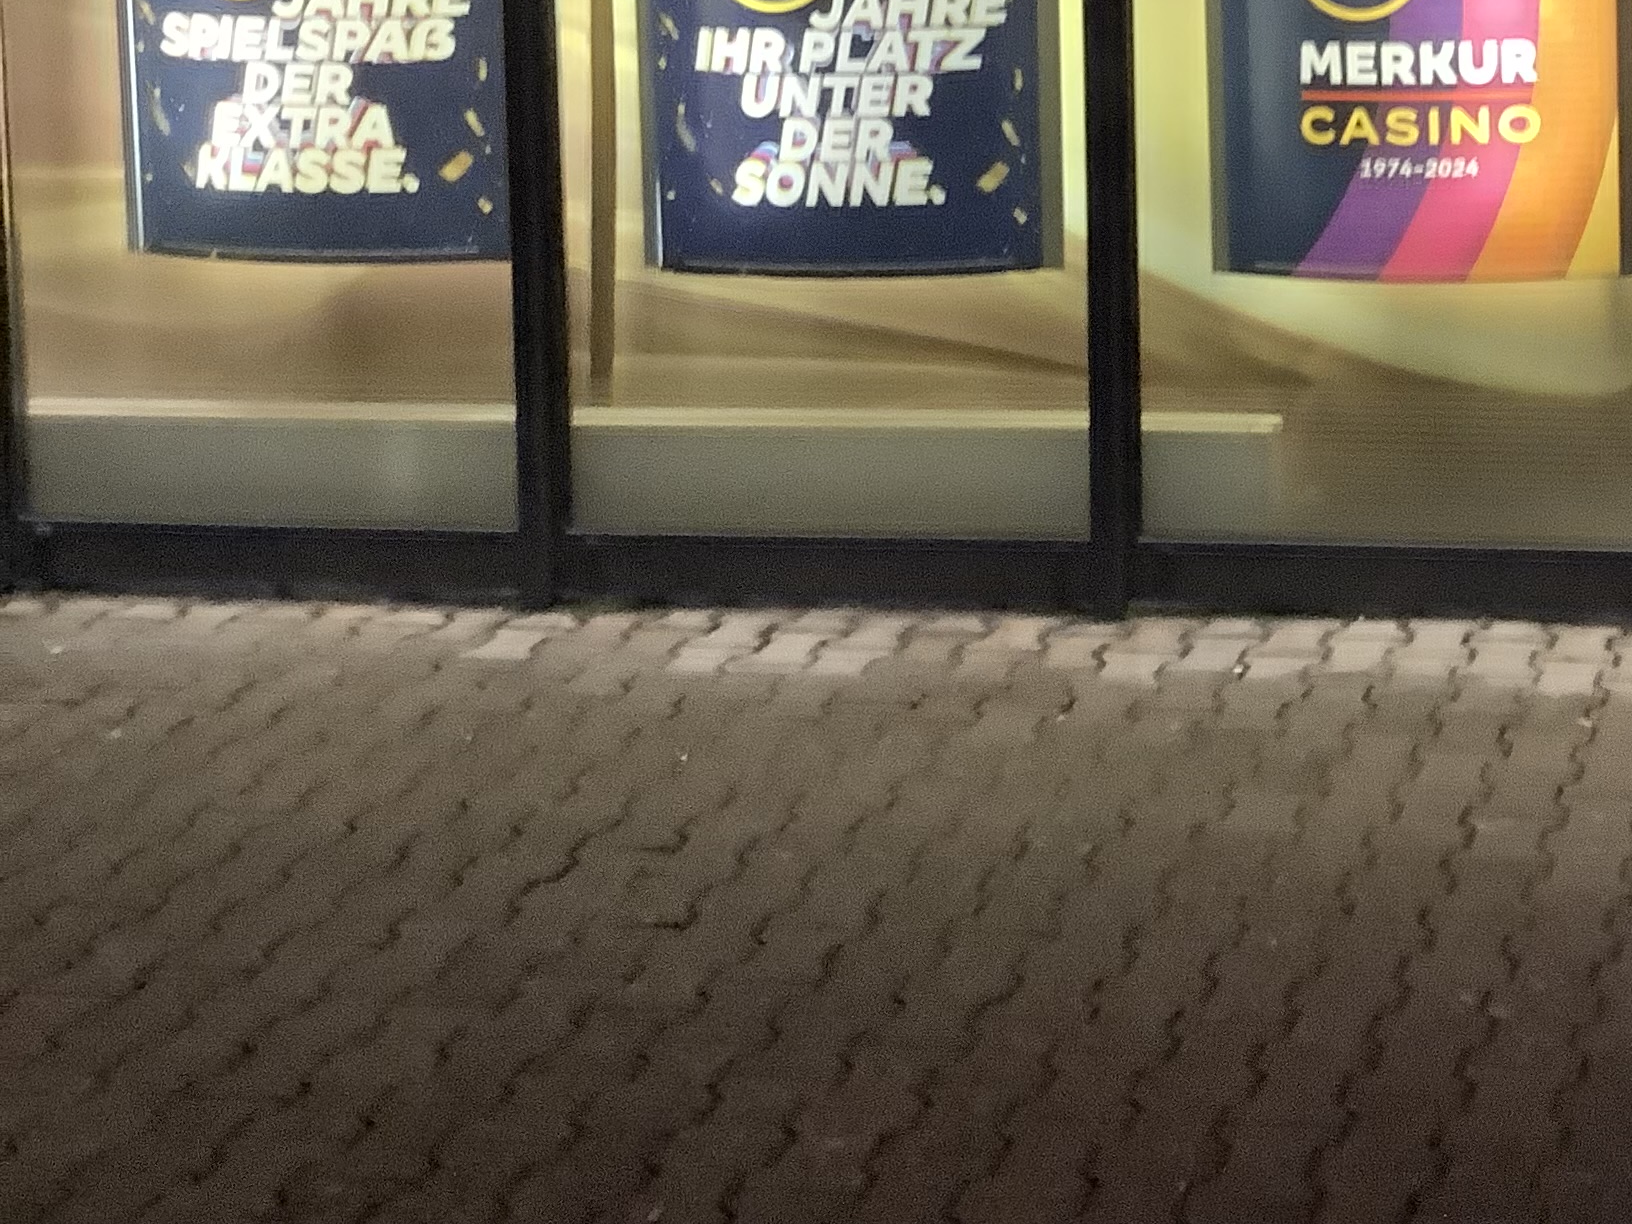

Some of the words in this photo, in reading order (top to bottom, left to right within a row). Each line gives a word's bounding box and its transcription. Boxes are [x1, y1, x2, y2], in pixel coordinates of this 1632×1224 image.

[695, 26, 787, 73] IHR
[800, 28, 986, 73] PLATZ
[1300, 38, 1537, 85] MERKUR
[242, 62, 354, 105] DER
[740, 73, 933, 118] UNTER
[211, 102, 395, 150] EXTRA
[779, 117, 894, 164] DER
[1300, 105, 1541, 145] CASINO
[196, 146, 420, 194] KLASSE.
[732, 159, 946, 207] SONNE.
[1360, 157, 1479, 179] 1974-2024
